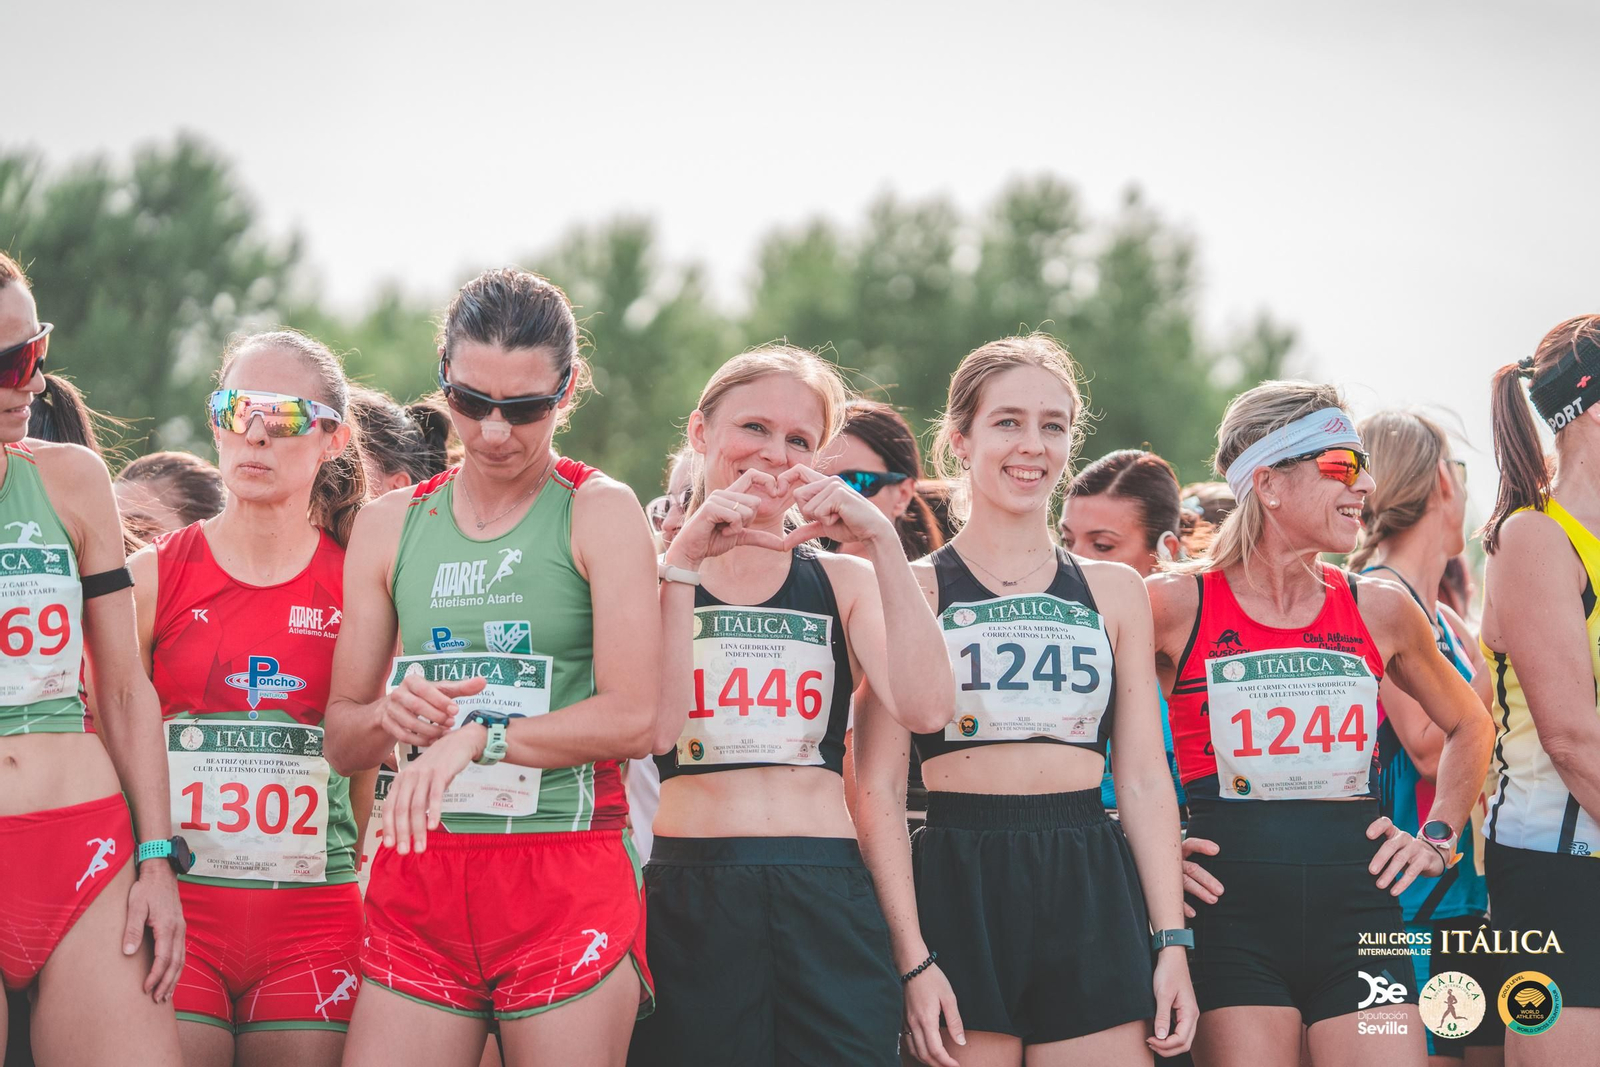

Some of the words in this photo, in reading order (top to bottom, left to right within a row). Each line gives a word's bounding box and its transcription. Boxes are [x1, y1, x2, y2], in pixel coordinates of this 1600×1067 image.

[430, 559, 488, 598] ATARFE
[27, 587, 58, 596] ATARFE
[430, 597, 484, 609] Atletismo
[486, 592, 523, 604] Atarfe
[288, 605, 324, 630] ATARFE
[988, 600, 1064, 619] ITÁLICA
[288, 627, 322, 637] Atletismo
[713, 613, 792, 634] ITÁLICA
[431, 627, 465, 650] Poncho
[1303, 633, 1324, 643] Club
[1327, 632, 1364, 644] Atletismo
[249, 656, 296, 688] Poncho
[960, 643, 1100, 694] 1245
[1256, 655, 1334, 675] ITÁLICA
[517, 679, 536, 687] evilla
[1288, 682, 1316, 690] CHAVES
[688, 667, 823, 720] 1446
[492, 700, 522, 708] ATARFE
[215, 727, 294, 749] ITÁLICA
[1231, 704, 1368, 758] 1244
[239, 759, 275, 767] QUEVEDO
[258, 767, 286, 775] CIUDAD
[181, 782, 319, 835] 1302
